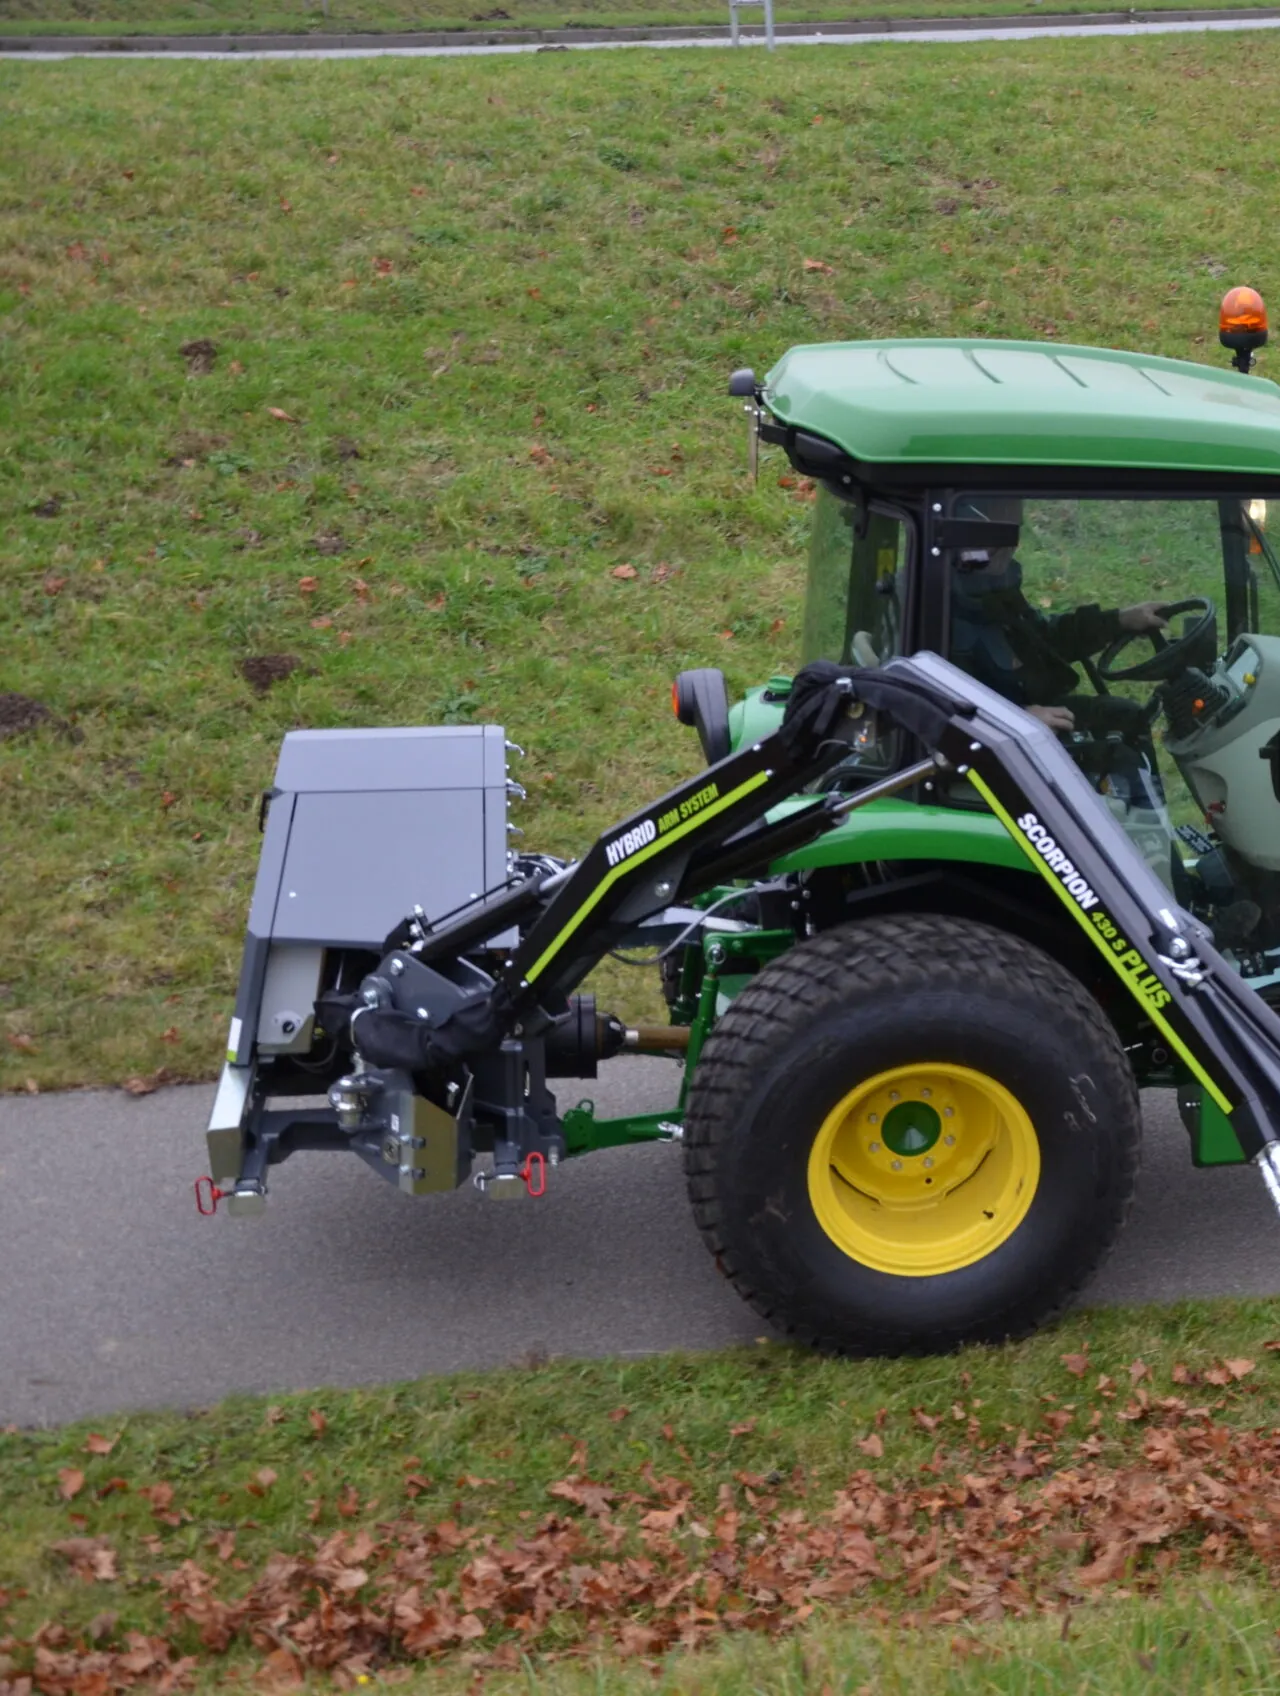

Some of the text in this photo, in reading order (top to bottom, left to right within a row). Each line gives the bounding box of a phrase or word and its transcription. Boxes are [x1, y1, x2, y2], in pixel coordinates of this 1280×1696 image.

[605, 782, 719, 866] HYBRID ARM SYSTEM
[1017, 812, 1172, 1008] SCORPION 430 S PLUS
